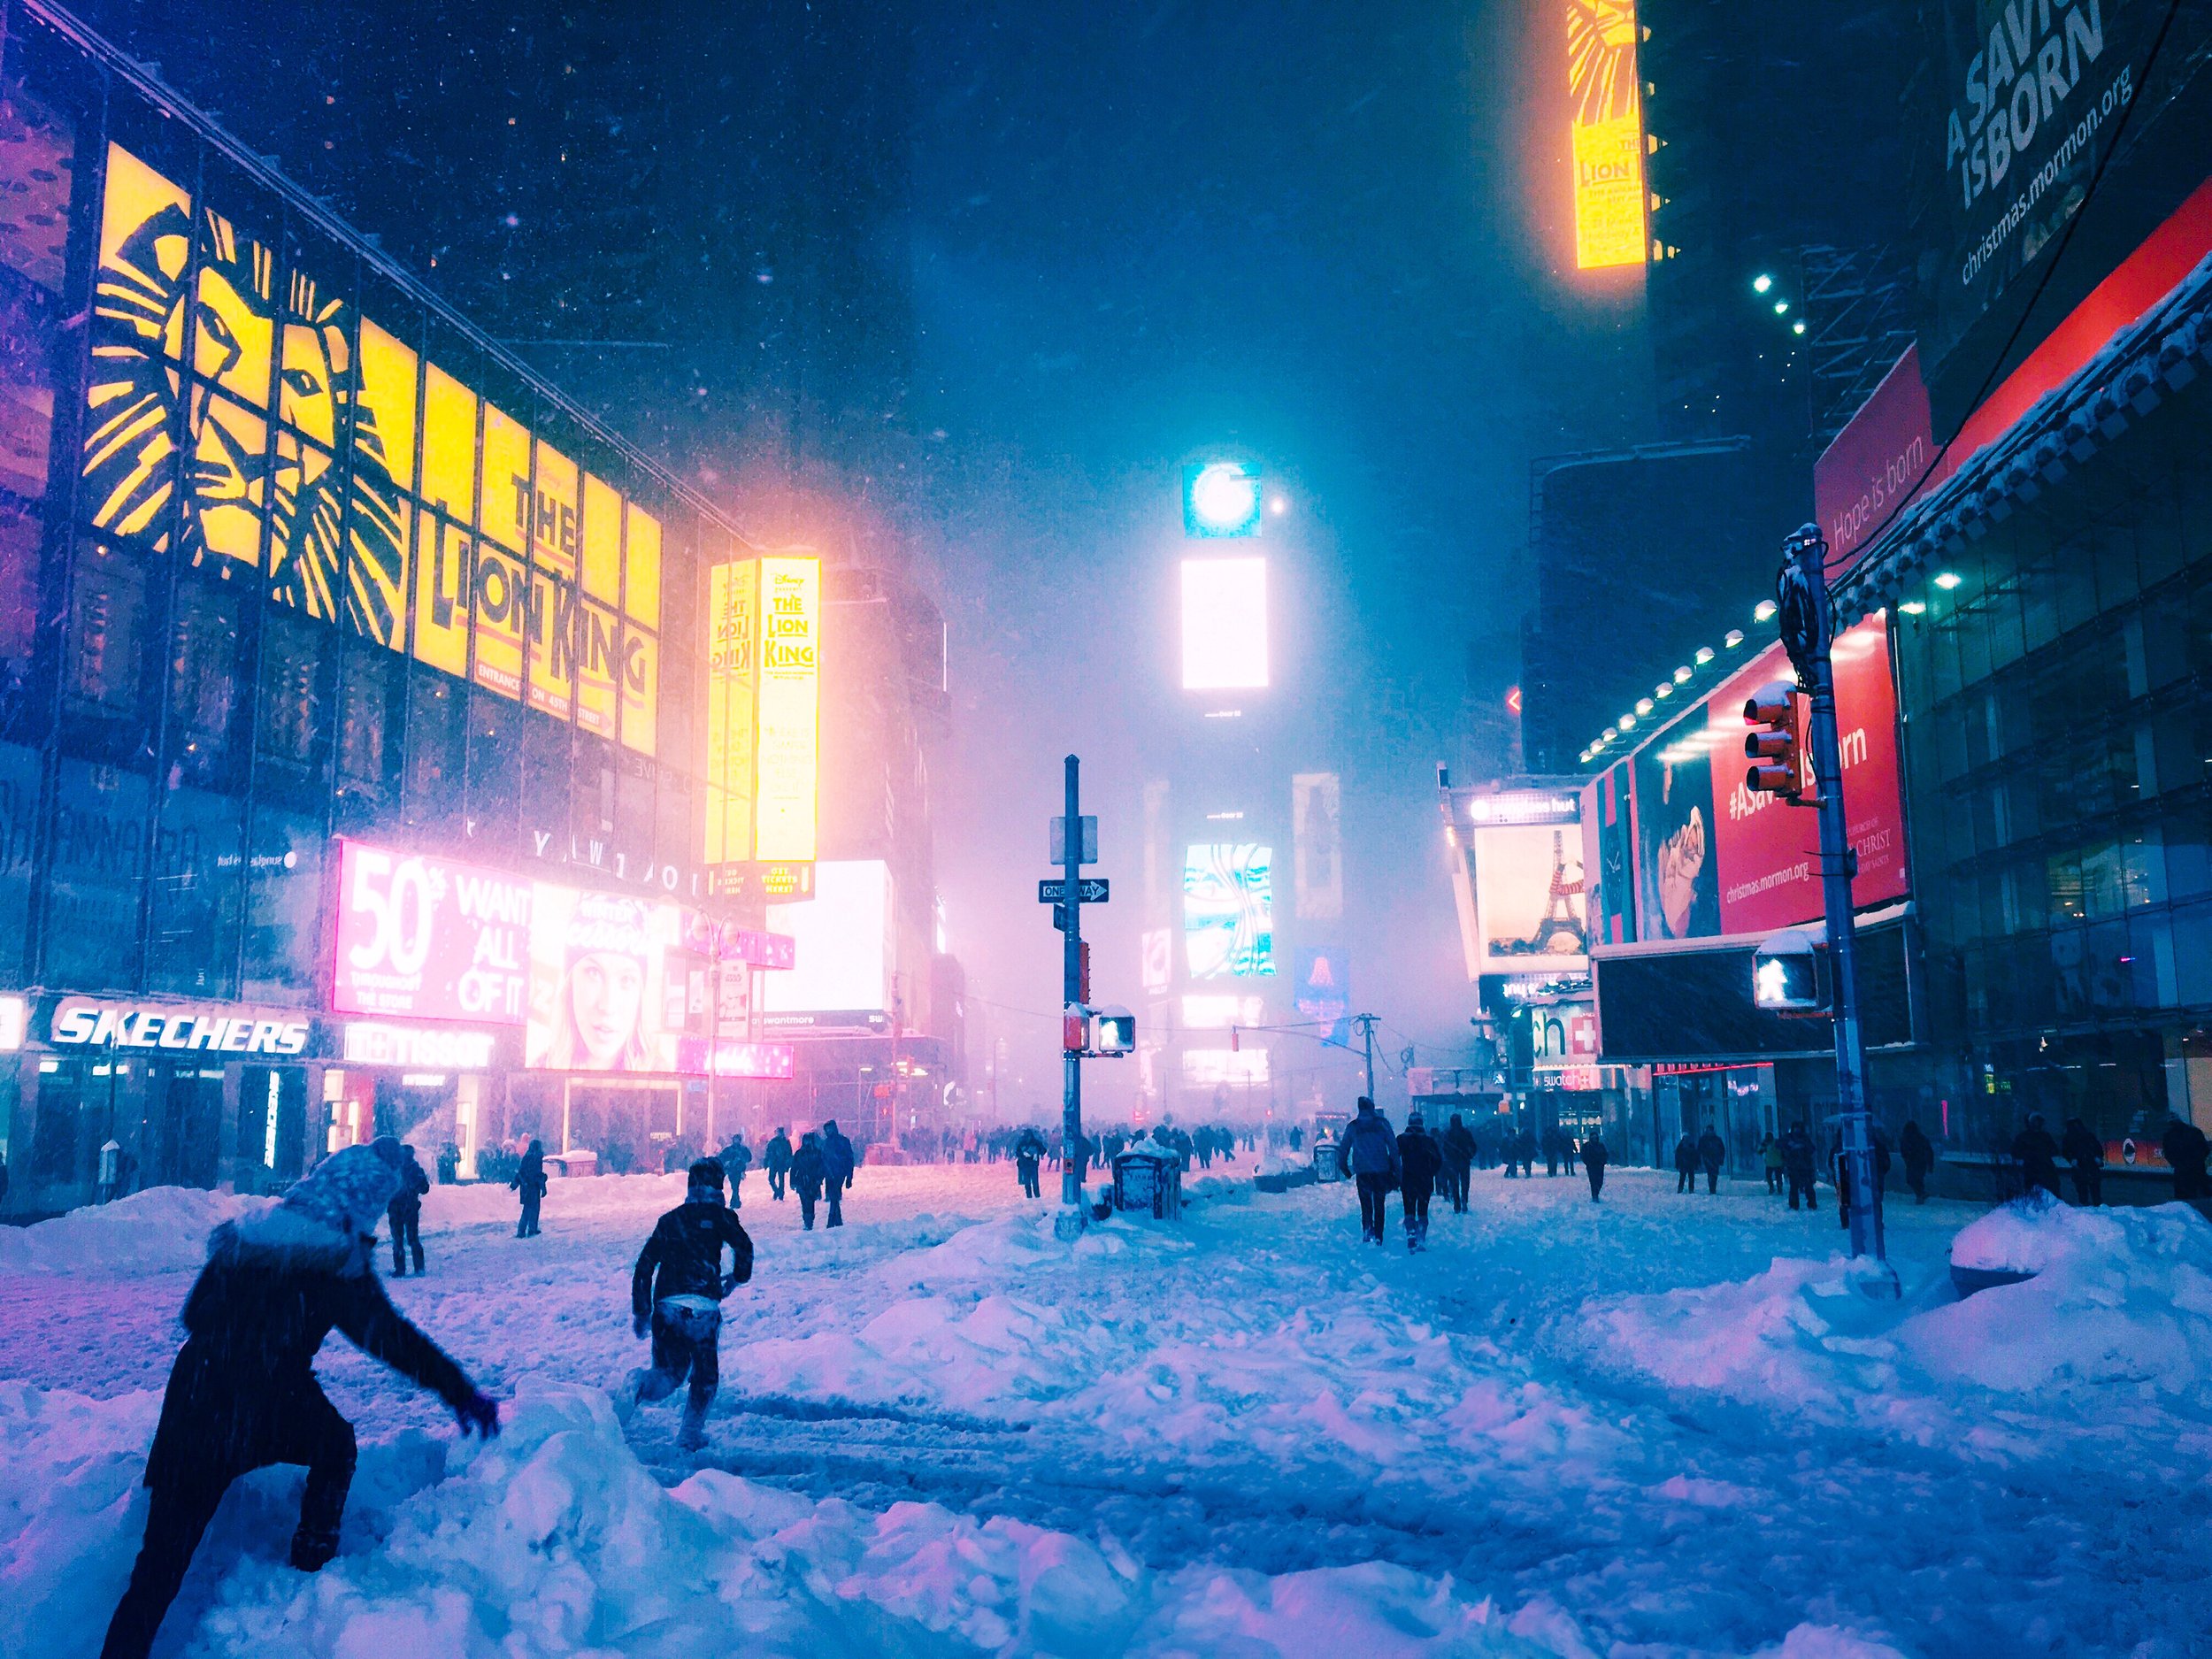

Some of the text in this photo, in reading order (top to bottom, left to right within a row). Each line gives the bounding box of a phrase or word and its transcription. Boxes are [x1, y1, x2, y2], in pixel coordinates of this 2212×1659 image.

[1947, 0, 2072, 171] A SAVI
[1962, 0, 2104, 212] IS BORN
[1579, 159, 1630, 188] LION
[1962, 64, 2133, 286] christmas.mormon.org
[511, 472, 575, 557] THE
[1833, 435, 1924, 551] Hope is born
[431, 496, 646, 695] LION KING
[772, 595, 803, 611] THE
[767, 614, 809, 638] LION
[764, 640, 815, 668] KING
[478, 664, 601, 726] ENTRANCE ON 45TH STREET
[1494, 799, 1550, 819] sunglass
[1551, 798, 1575, 812] hut
[1856, 828, 1891, 857] CHRIST
[455, 873, 532, 927] WANT
[1045, 886, 1065, 896] ONE
[1726, 861, 1809, 904] christmas.mormon.org
[472, 926, 519, 971] ALL
[457, 971, 504, 1013] OF
[505, 976, 525, 1016] IT
[53, 1006, 310, 1055] SKECHERS
[395, 1029, 495, 1068] TISSOT
[1543, 1073, 1580, 1087] swatch
